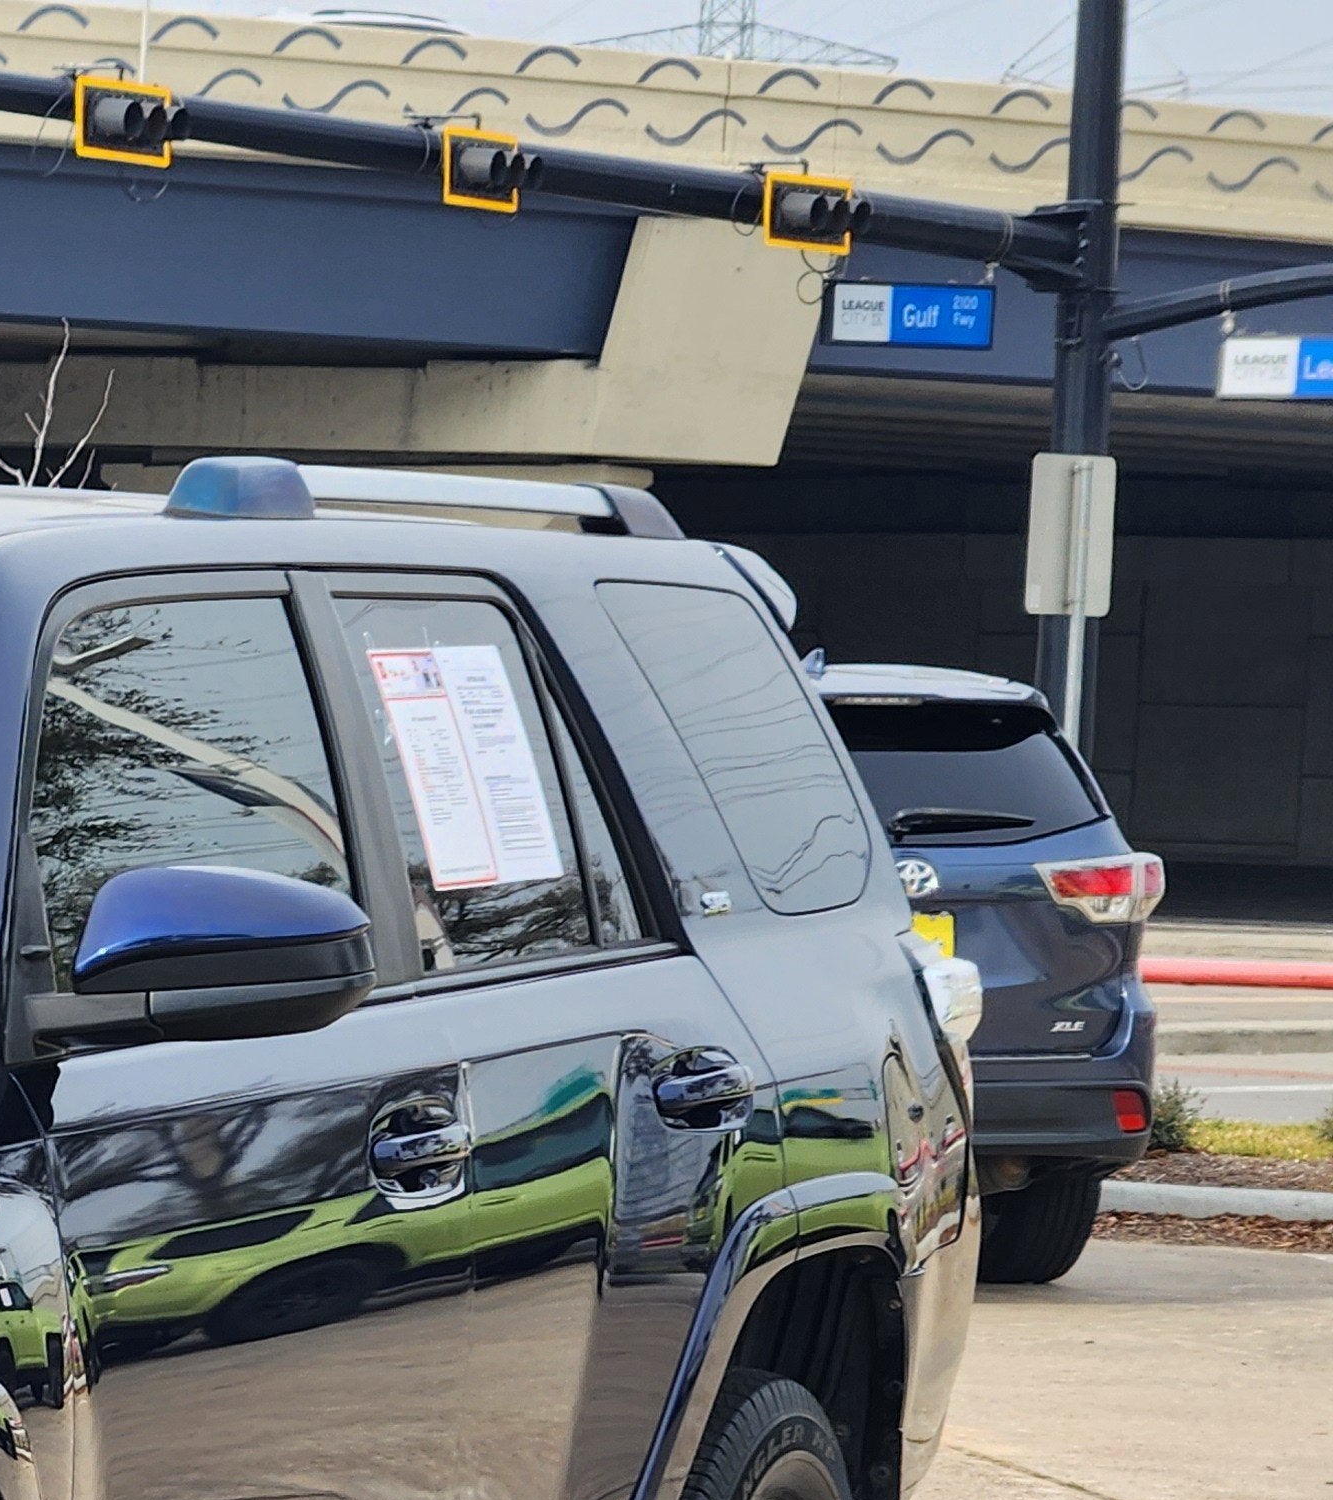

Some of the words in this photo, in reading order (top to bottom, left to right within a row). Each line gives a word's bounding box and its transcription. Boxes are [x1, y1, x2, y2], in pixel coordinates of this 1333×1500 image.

[841, 299, 885, 312] LEAGUE
[902, 303, 941, 329] Gulf
[952, 311, 977, 330] Fwy
